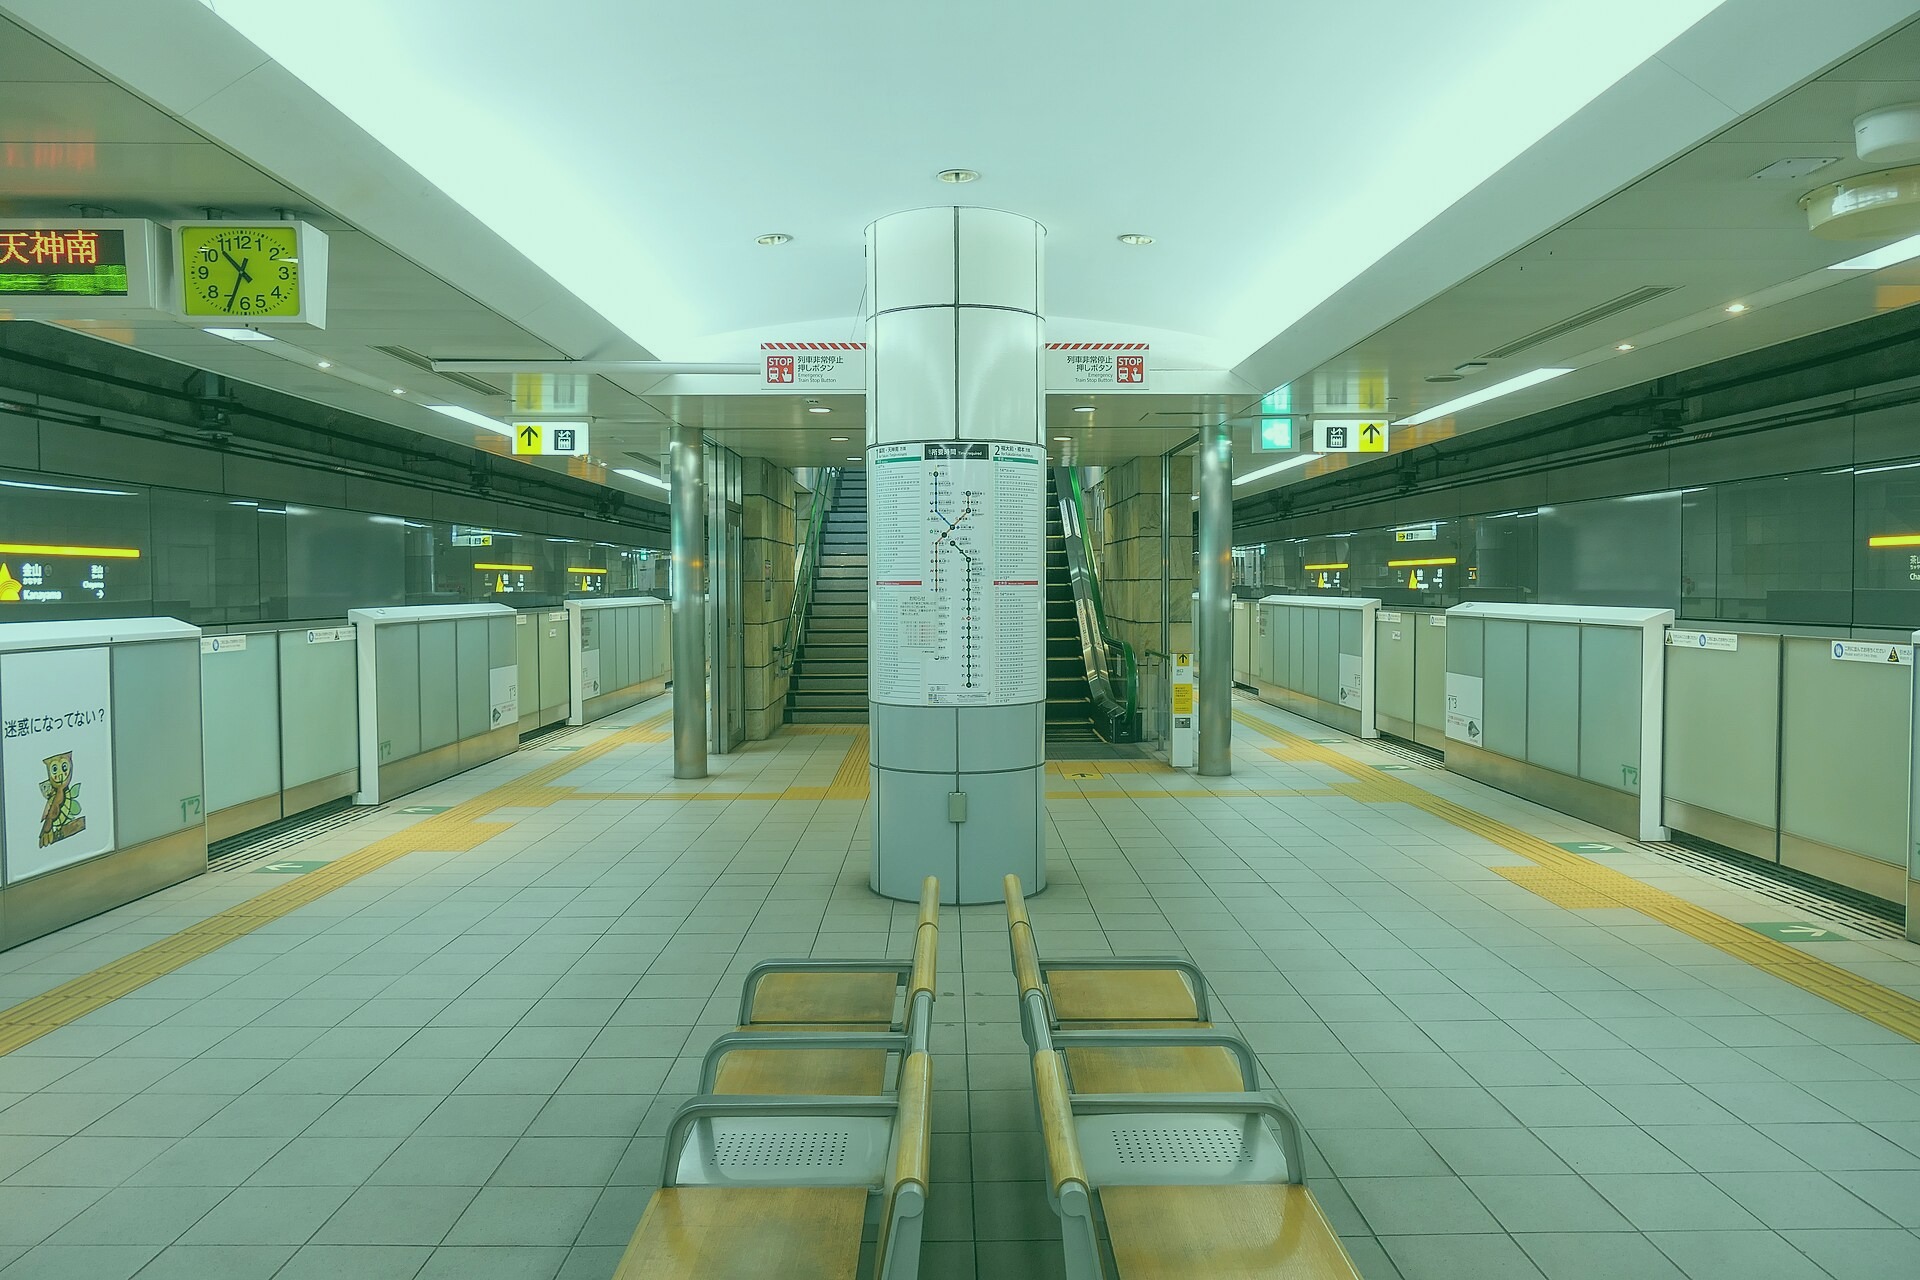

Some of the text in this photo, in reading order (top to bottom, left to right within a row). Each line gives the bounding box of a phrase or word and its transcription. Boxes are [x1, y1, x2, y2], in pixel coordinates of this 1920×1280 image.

[0, 230, 98, 263] 天神南
[218, 238, 231, 251] 11
[234, 236, 251, 249] 12
[255, 238, 261, 251] 1
[201, 249, 218, 262] 10
[269, 248, 280, 260] 2
[198, 266, 209, 279] 9
[278, 266, 289, 280] 3
[208, 285, 218, 298] 8
[271, 286, 282, 299] 4
[240, 297, 250, 310] 6
[255, 295, 266, 308] 5
[768, 357, 793, 366] STOP
[797, 356, 843, 364] 列車非常停止
[1066, 356, 1113, 364] 列車非常停止
[1118, 357, 1142, 366] STOP
[797, 364, 834, 372] 押しボタン
[1076, 364, 1113, 372] 押しボタン
[995, 445, 1000, 455] 2
[4, 708, 105, 739] 迷惑になってない？
[1622, 767, 1638, 786] 1 2
[181, 798, 201, 823] 1 2
